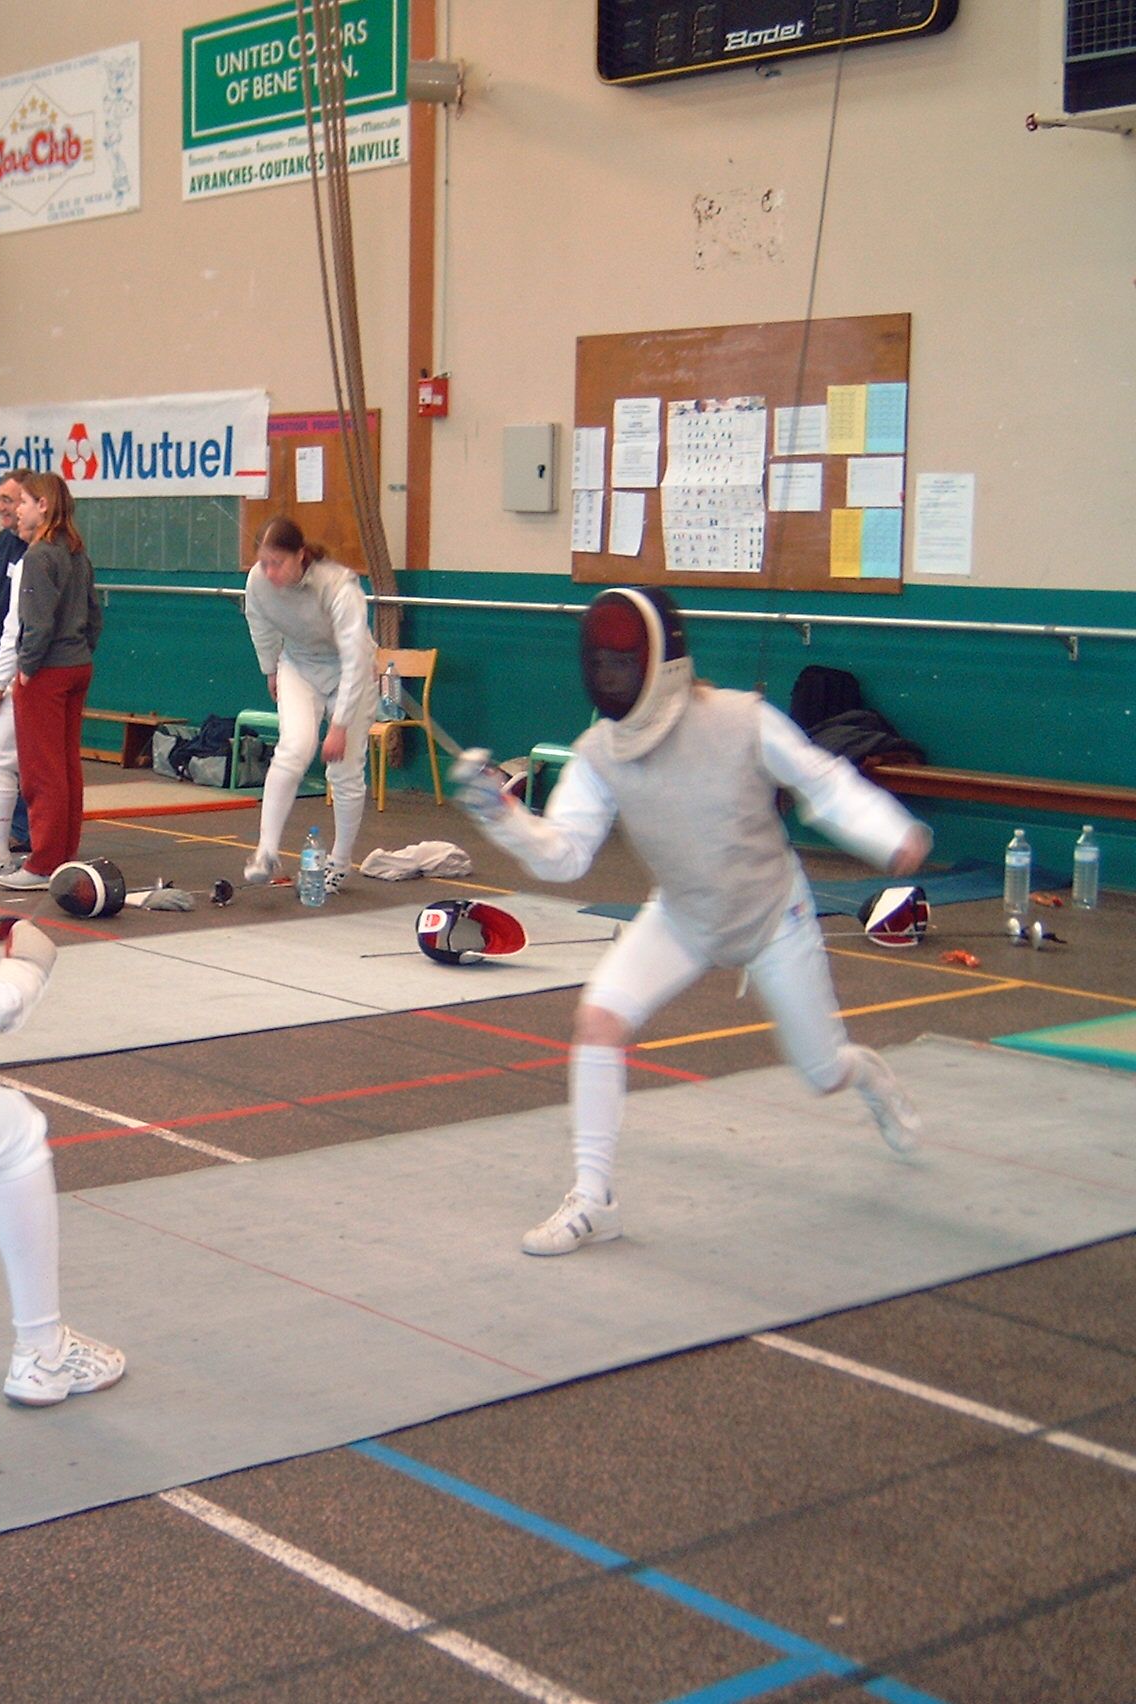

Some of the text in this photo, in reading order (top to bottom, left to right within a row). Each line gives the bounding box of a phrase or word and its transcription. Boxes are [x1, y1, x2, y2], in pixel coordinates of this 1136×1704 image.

[216, 19, 368, 77] UNITED CORS
[724, 20, 805, 51] Bodet
[226, 55, 359, 105] OF BENETN.
[101, 425, 233, 480] Mutuel
